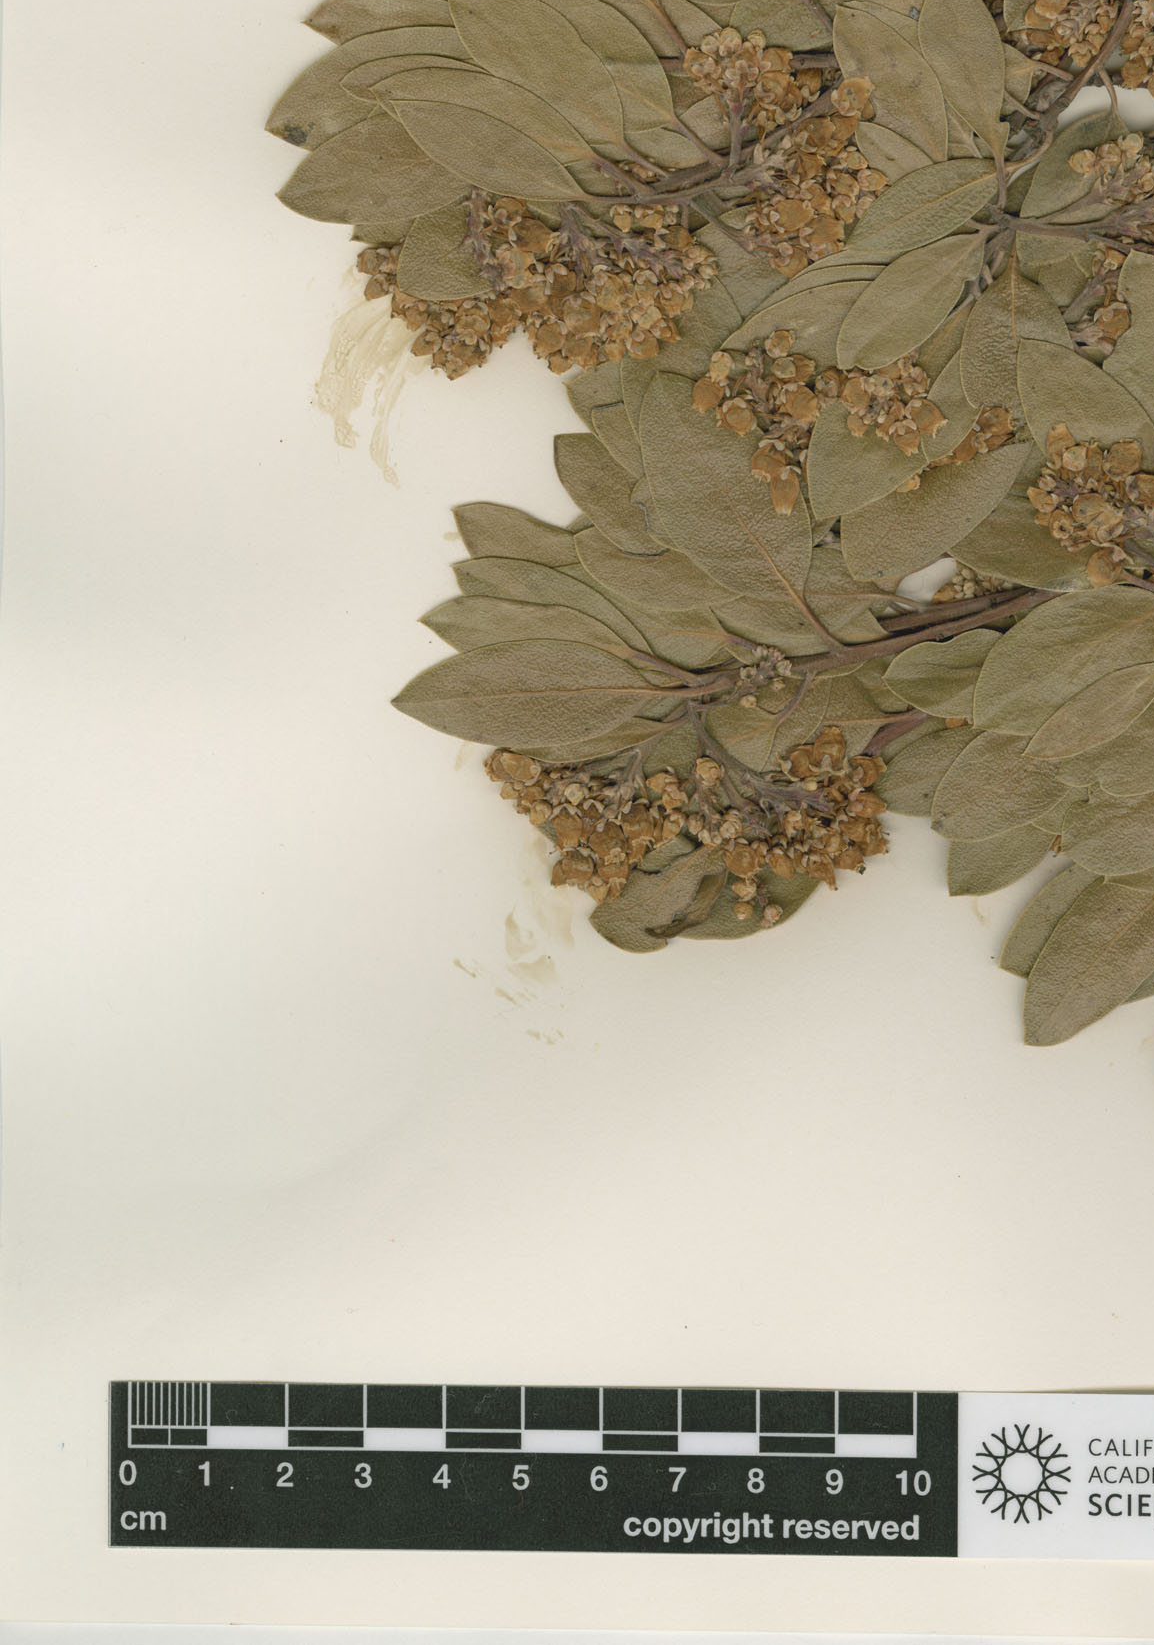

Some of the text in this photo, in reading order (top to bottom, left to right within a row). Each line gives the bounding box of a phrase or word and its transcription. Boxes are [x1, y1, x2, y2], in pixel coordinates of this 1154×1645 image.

[119, 1460, 933, 1496] 0 1 2 3 4 5 6 7 8 9 10
[121, 1511, 166, 1530] cm
[624, 1512, 919, 1544] copyright reserved
